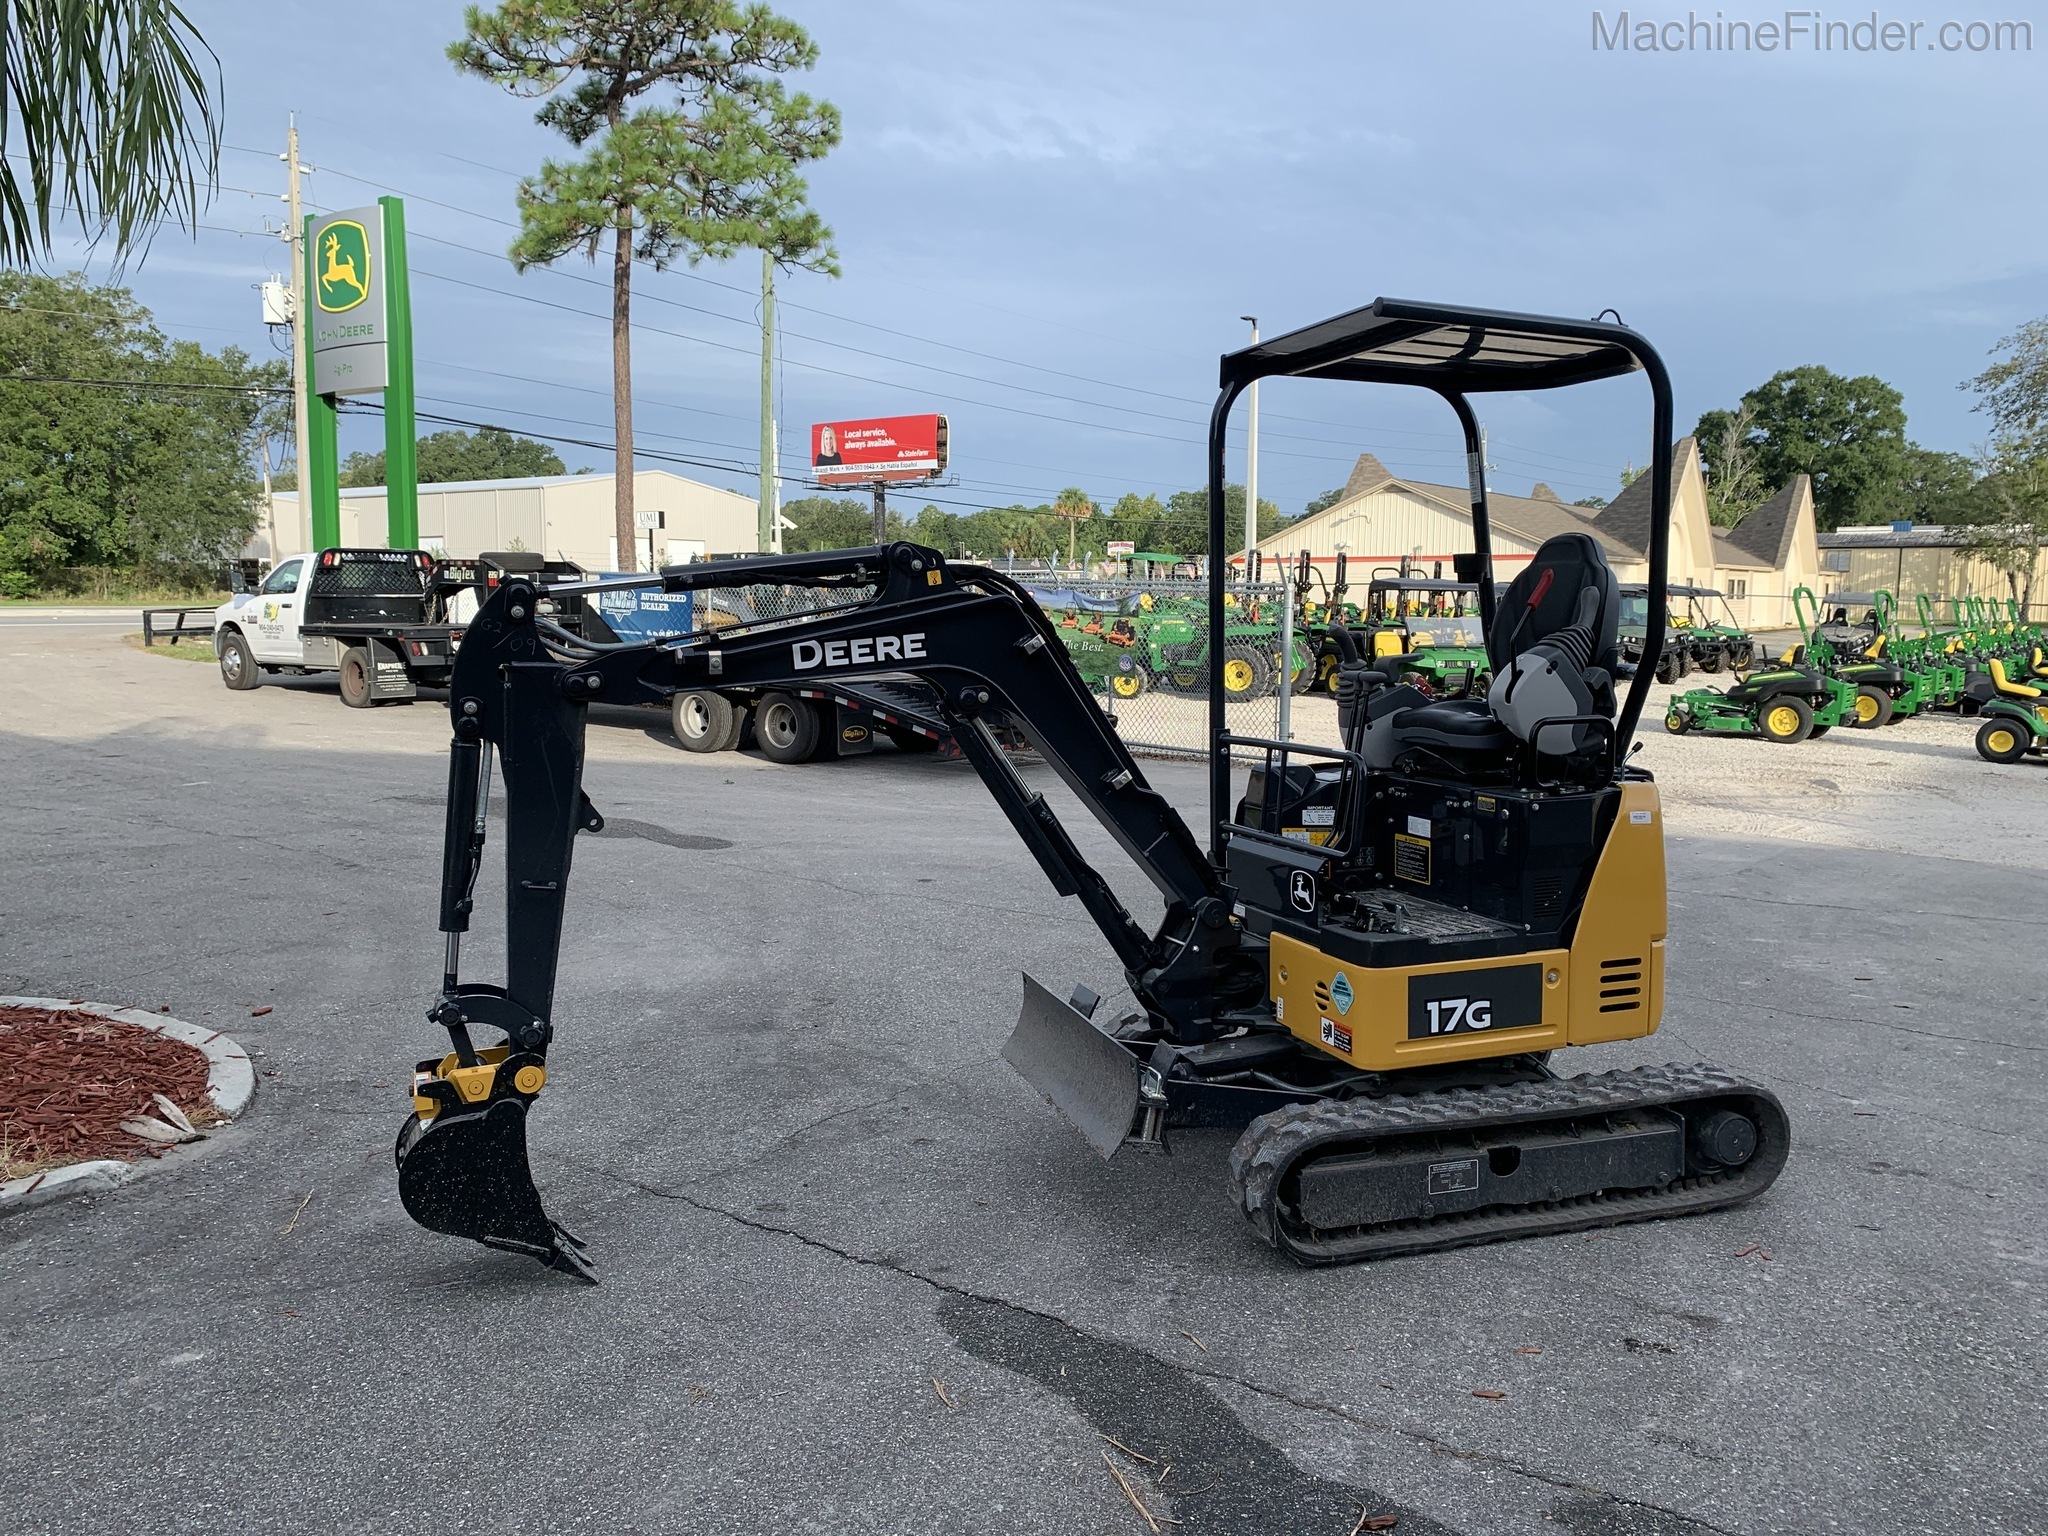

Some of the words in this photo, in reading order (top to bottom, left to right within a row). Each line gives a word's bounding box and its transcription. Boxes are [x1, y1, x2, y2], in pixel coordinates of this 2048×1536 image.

[339, 324, 374, 338] DEERE
[844, 430, 861, 439] Local
[862, 428, 887, 438] service,
[844, 442, 866, 451] always
[867, 438, 897, 447] available.
[449, 566, 475, 583] BigTex
[641, 593, 687, 602] AUTHORIZED
[792, 633, 927, 670] DEERE
[1062, 639, 1079, 650] The
[1081, 641, 1104, 652] Best.
[1426, 998, 1492, 1034] 17G
